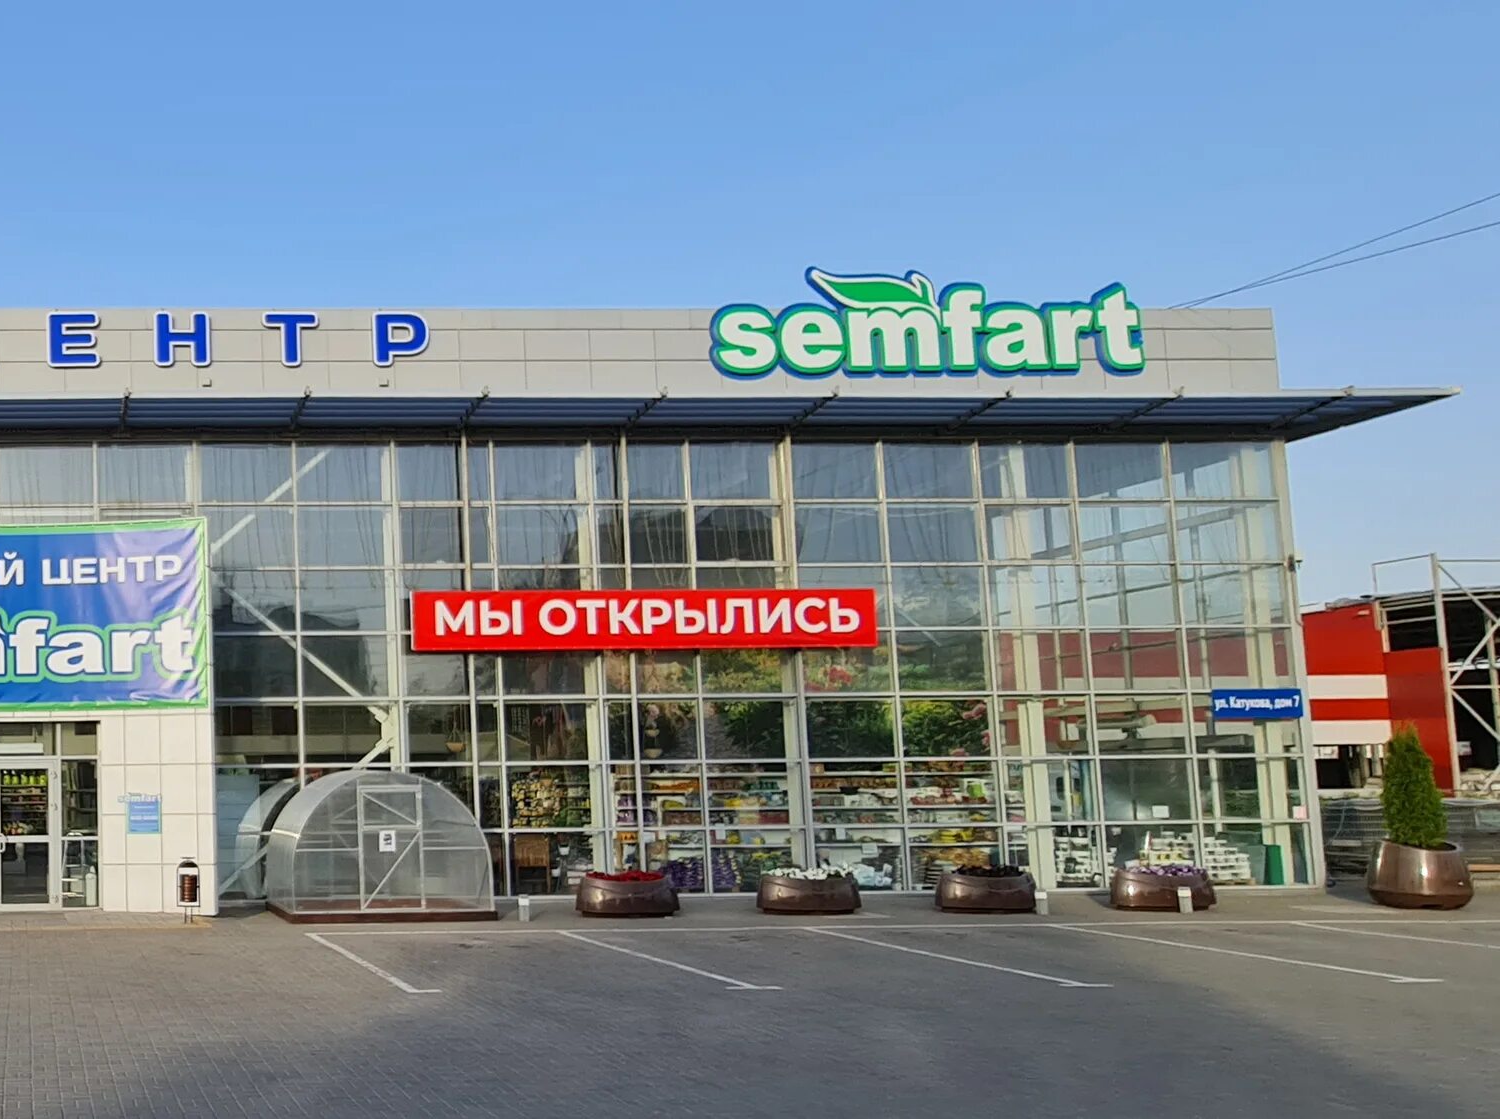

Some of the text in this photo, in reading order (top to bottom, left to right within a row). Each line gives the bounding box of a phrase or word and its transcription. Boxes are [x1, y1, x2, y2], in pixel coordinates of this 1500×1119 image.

[714, 282, 1145, 371] semfart
[41, 554, 183, 586] ЦЕНТР
[434, 598, 861, 636] МЫ ОТКРЫЛИСЬ
[1293, 695, 1300, 707] 7
